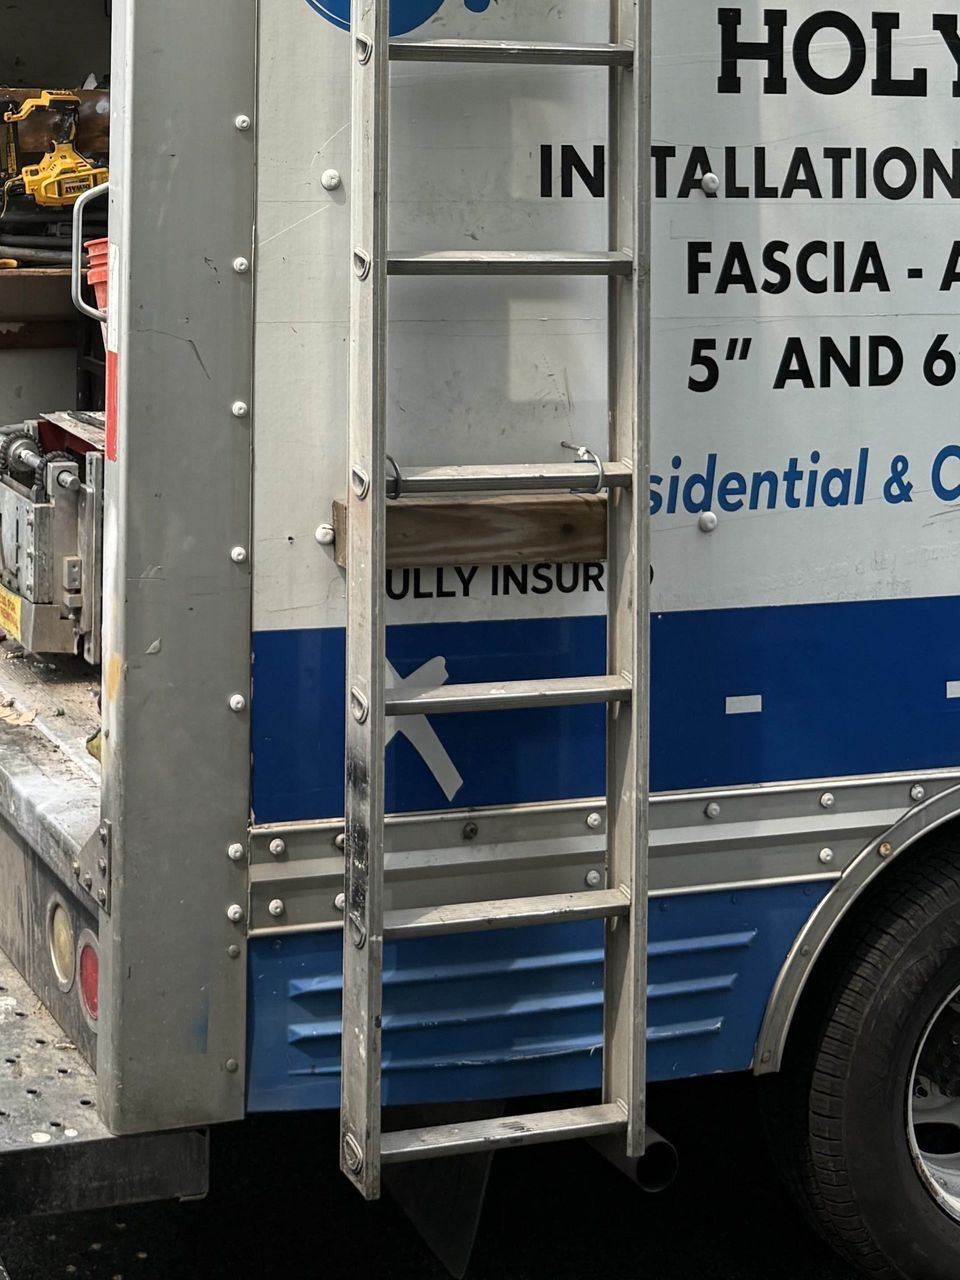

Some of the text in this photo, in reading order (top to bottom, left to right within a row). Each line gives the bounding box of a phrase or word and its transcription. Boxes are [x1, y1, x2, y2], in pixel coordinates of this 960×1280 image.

[540, 144, 960, 200] INTALLATION
[687, 240, 890, 295] FASCIA
[773, 335, 904, 390] AND
[649, 448, 869, 516] sidential
[883, 454, 914, 504] &
[385, 562, 655, 600] ULLY INSUR
